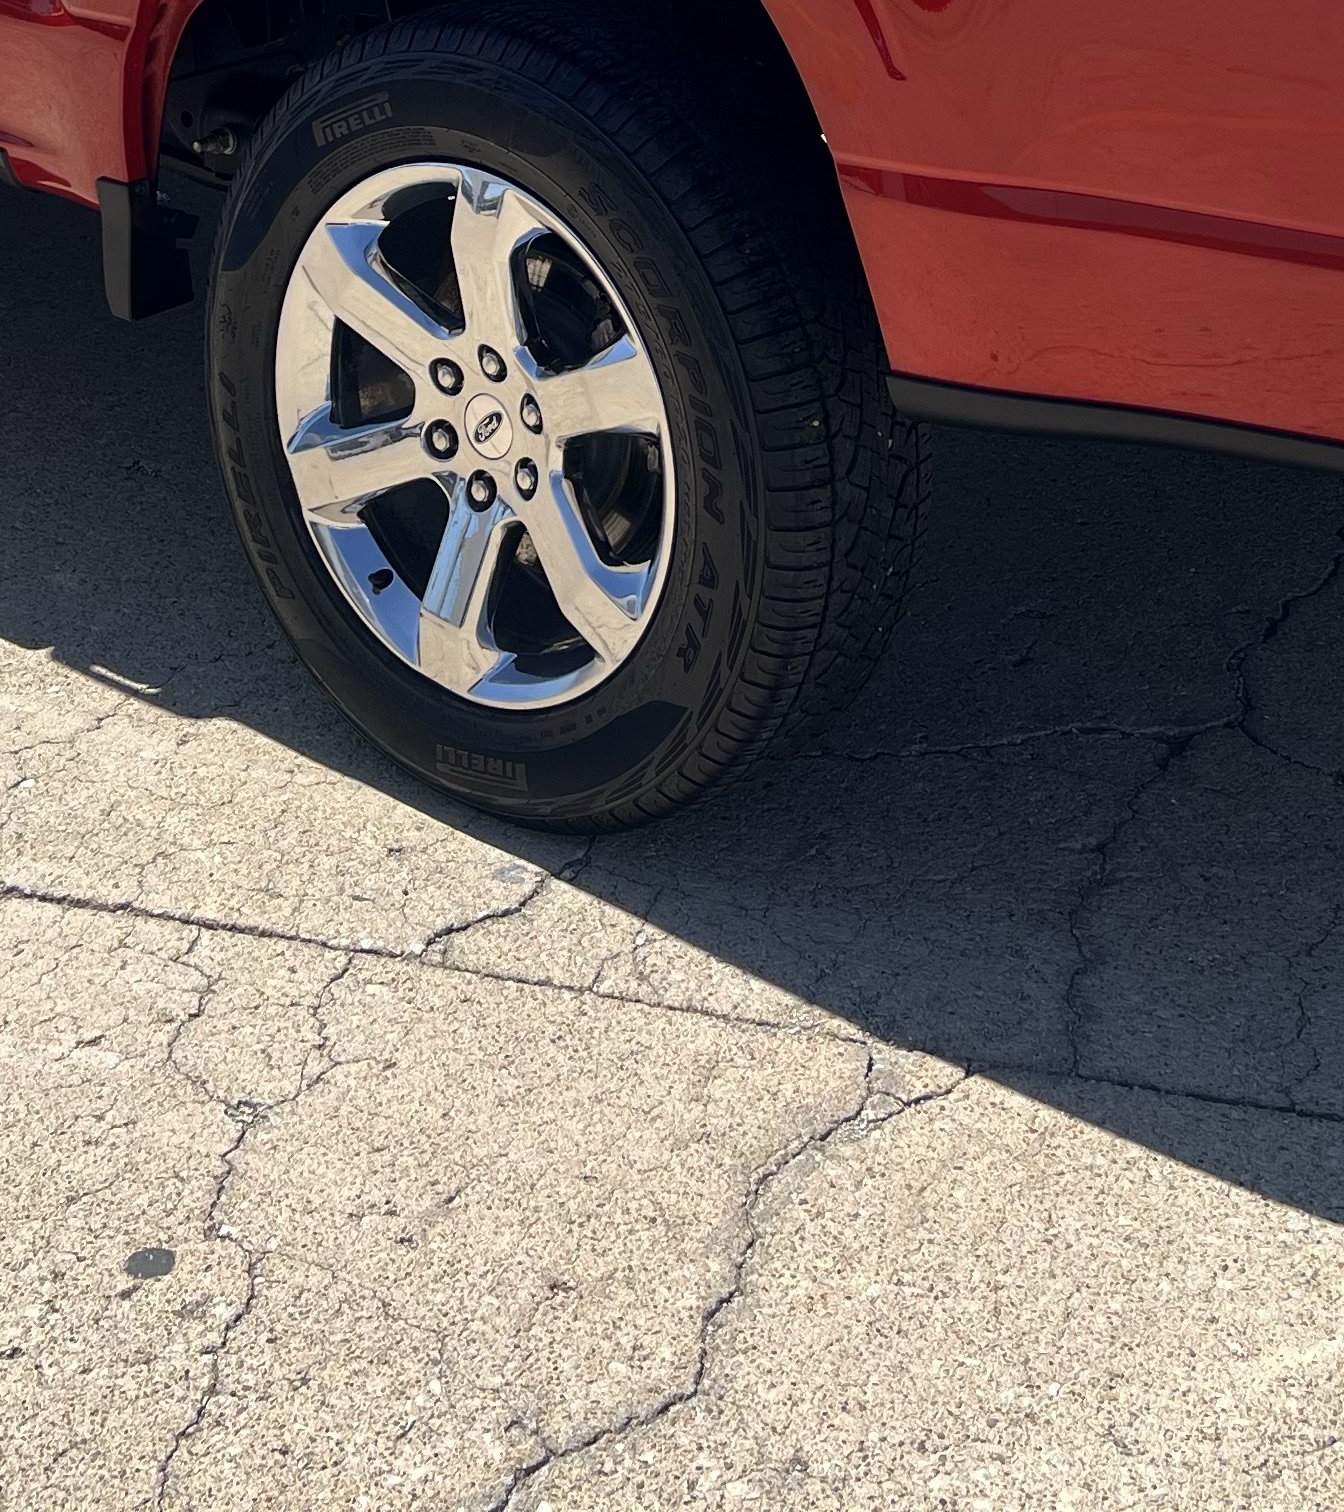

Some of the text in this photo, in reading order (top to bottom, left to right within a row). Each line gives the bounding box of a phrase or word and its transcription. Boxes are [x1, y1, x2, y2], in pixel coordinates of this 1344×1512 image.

[312, 91, 393, 148] PIRELLI
[218, 370, 296, 600] PIRELLI
[578, 185, 726, 673] SCORPION ATR
[436, 743, 529, 792] PIRELLI
